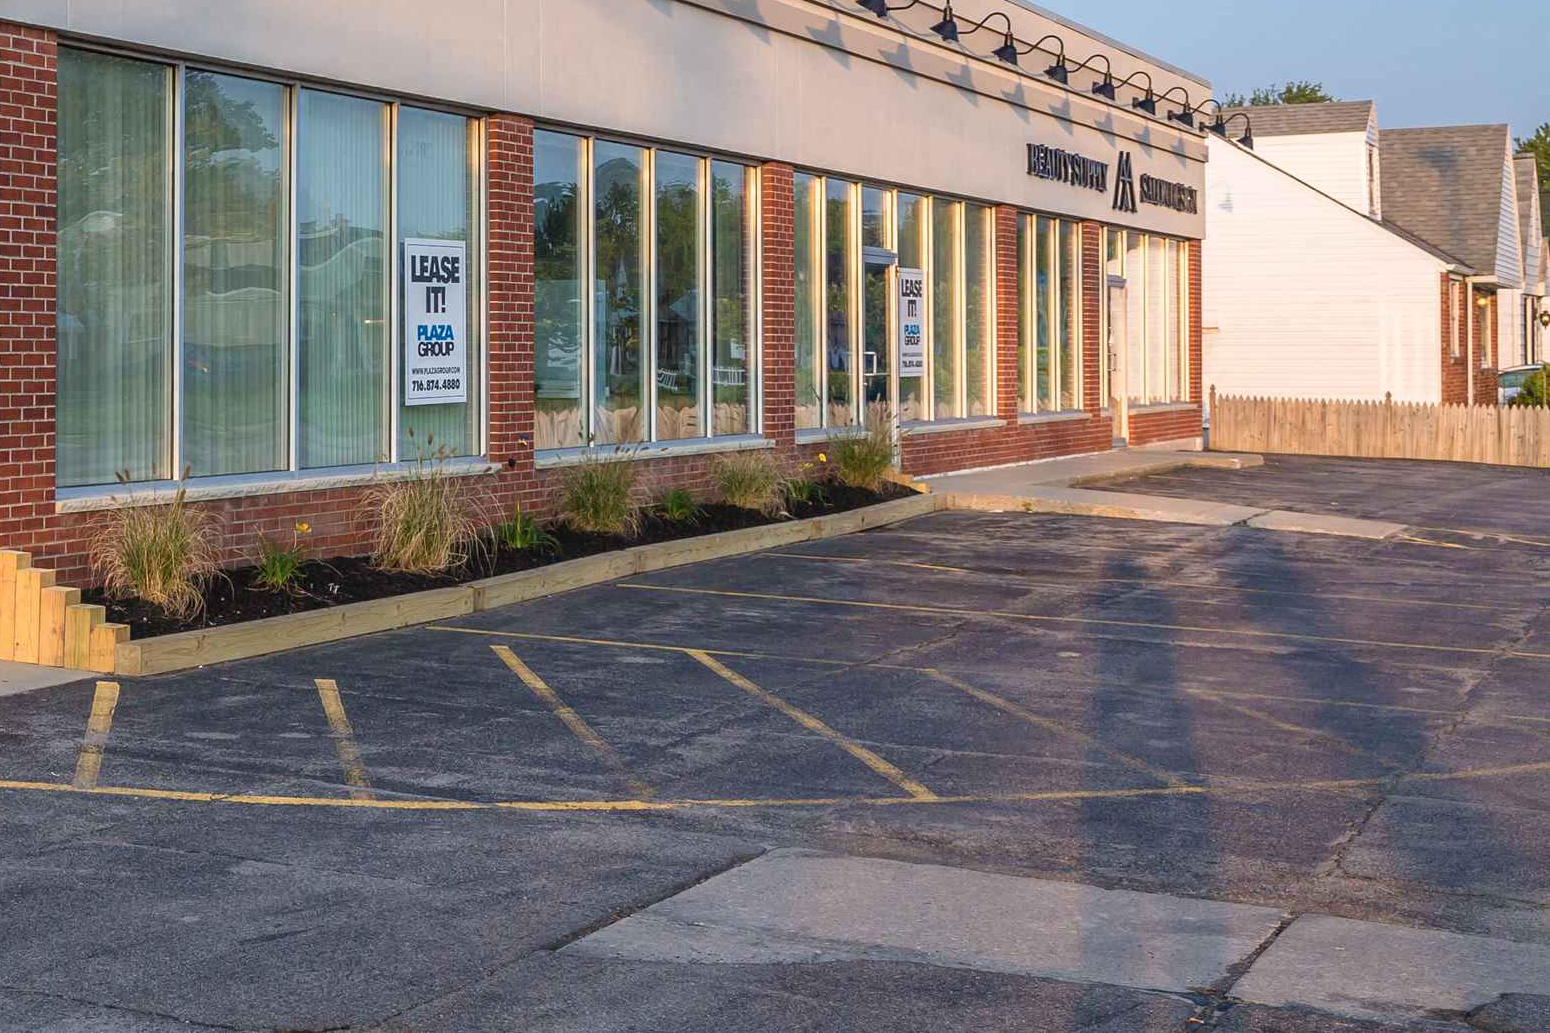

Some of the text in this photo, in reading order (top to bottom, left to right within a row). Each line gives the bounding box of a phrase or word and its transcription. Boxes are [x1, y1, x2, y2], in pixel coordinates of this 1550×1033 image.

[1026, 143, 1072, 184] BEAUTY
[1071, 153, 1109, 193] SUPPLY
[411, 255, 460, 284] LEASE
[901, 279, 922, 298] LEASE
[426, 286, 446, 314] IT!
[907, 299, 917, 317] IT!
[417, 324, 454, 341] PLAZA
[418, 341, 455, 357] GROUP
[412, 379, 460, 391] 716.874.4880
